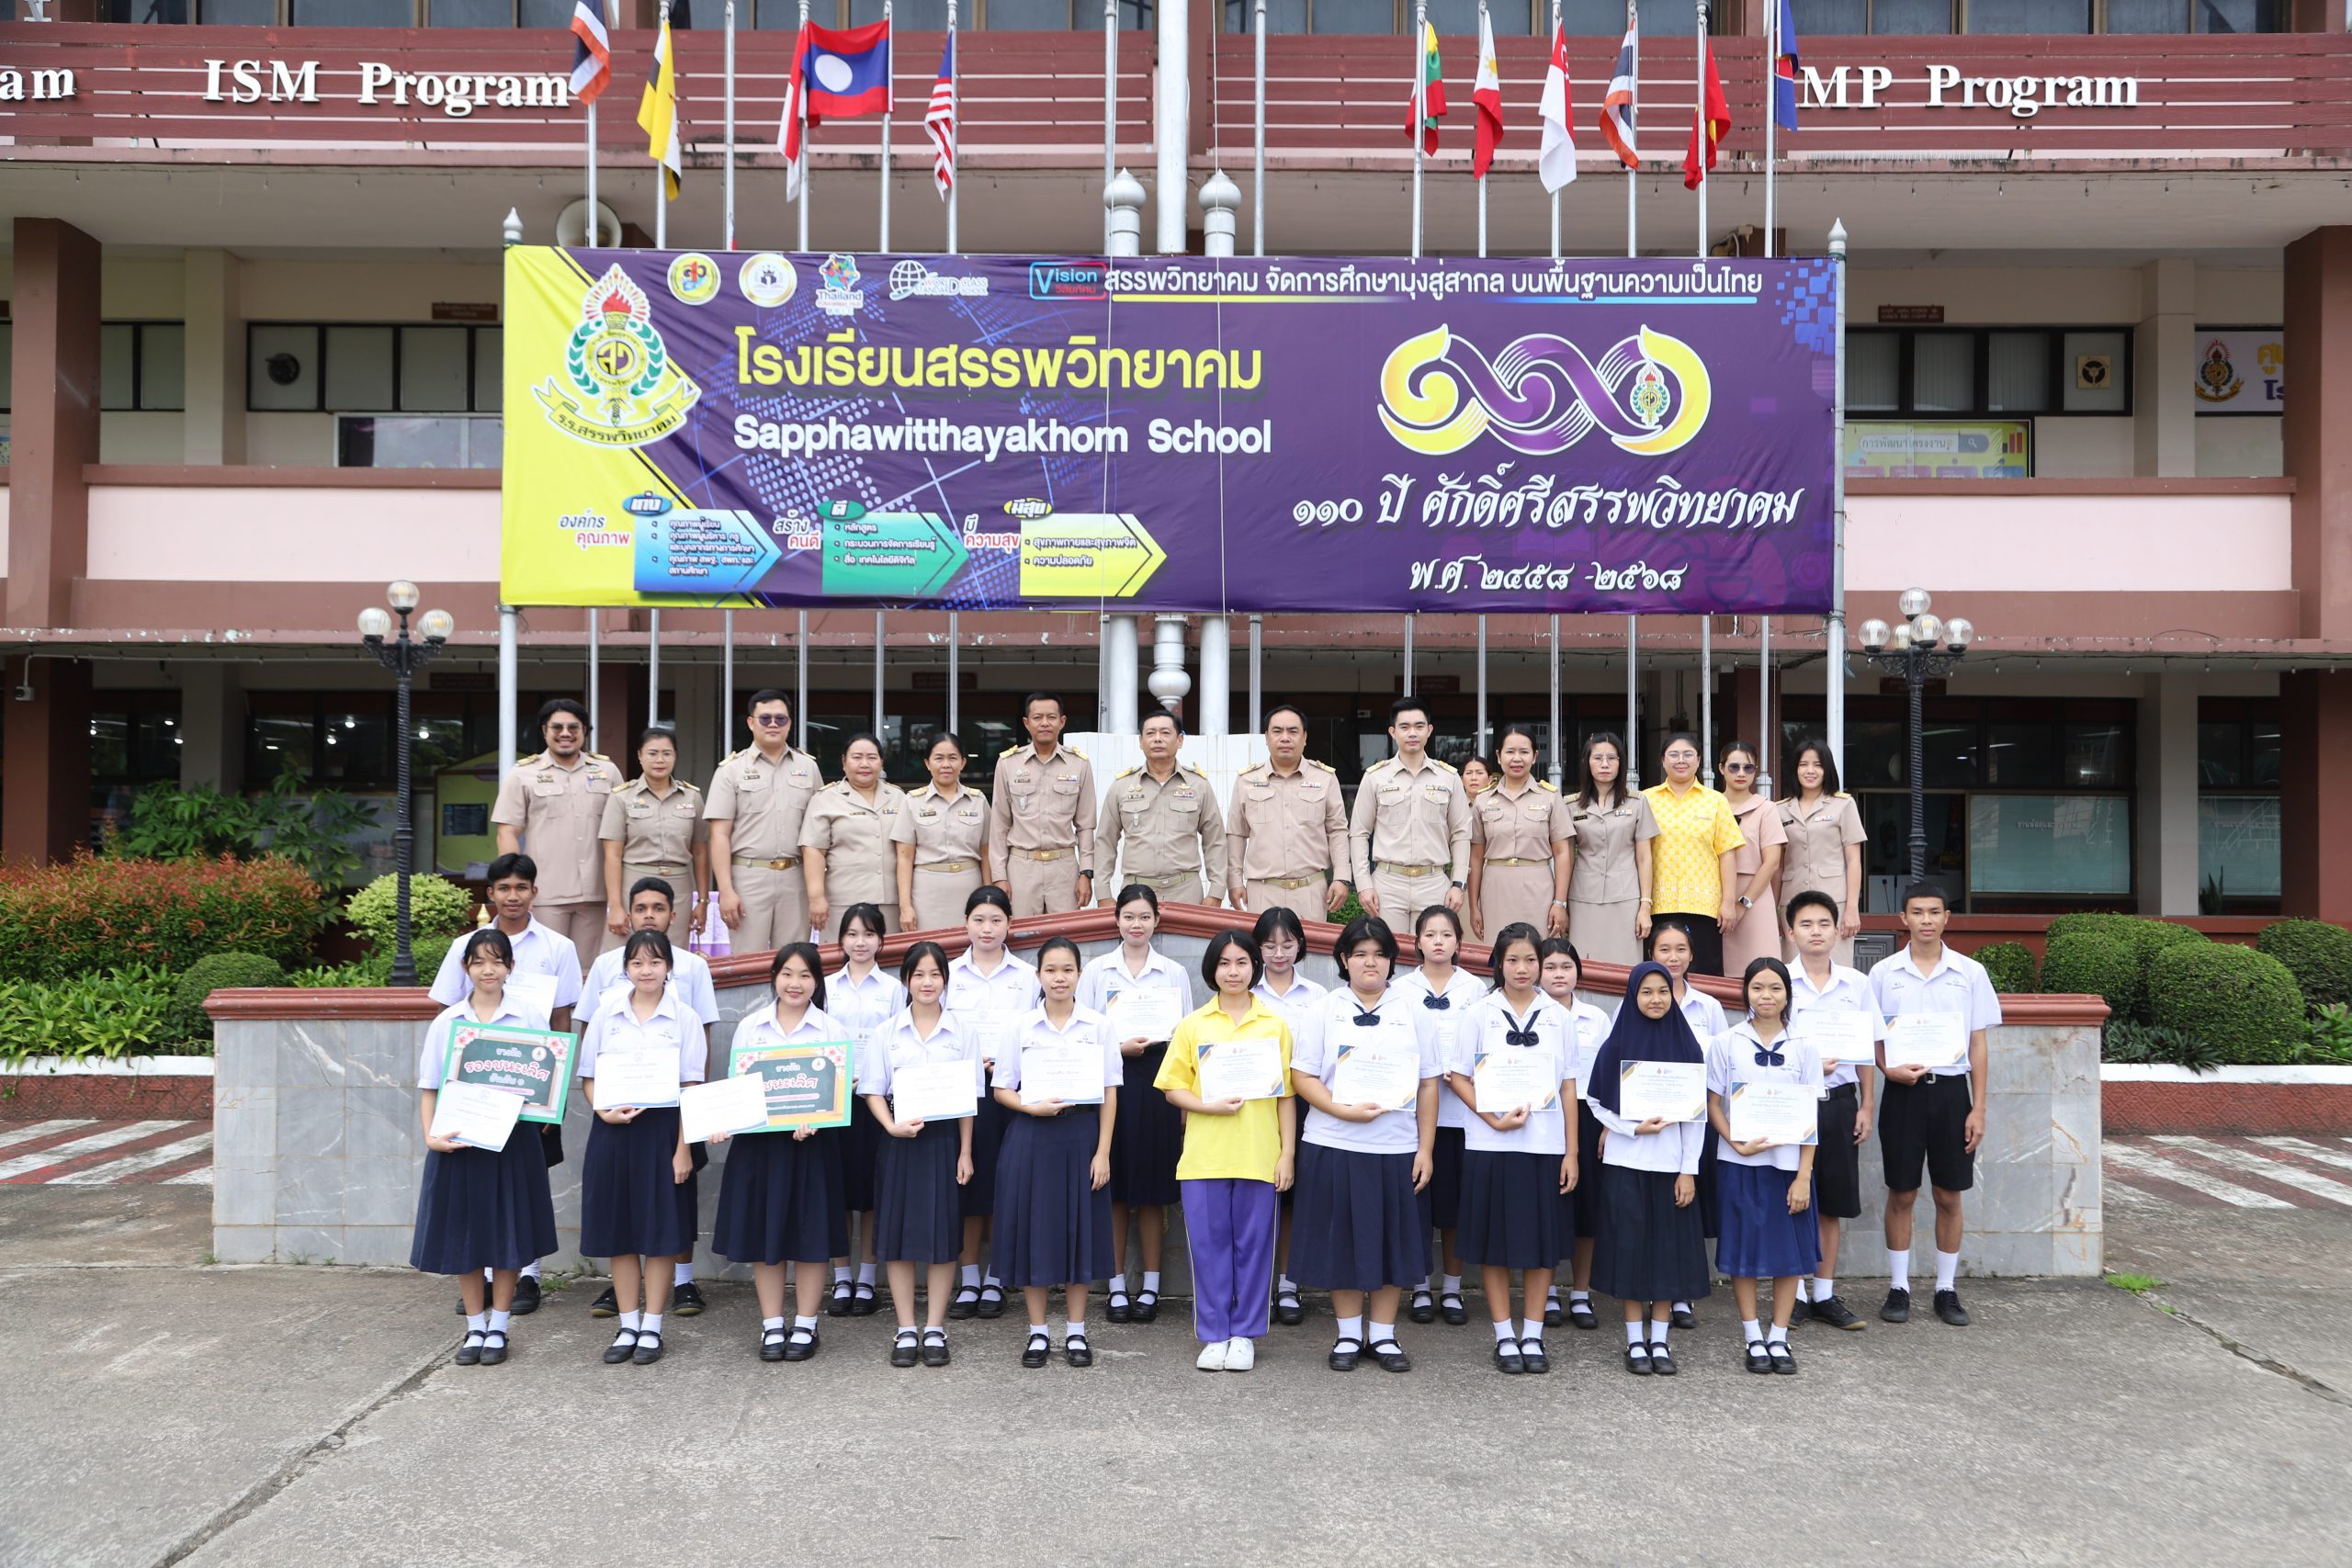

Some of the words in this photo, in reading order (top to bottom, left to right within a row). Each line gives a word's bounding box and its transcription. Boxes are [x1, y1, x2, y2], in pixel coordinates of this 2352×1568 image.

[203, 59, 321, 104] ISM
[358, 62, 571, 118] Program
[1926, 64, 2139, 118] Program
[1035, 268, 1098, 294] Vision
[1104, 266, 1257, 292] สรรพวิทยาคม
[1266, 258, 1505, 300] จัดการศึกษามุ่งสู่สากล
[1511, 258, 1763, 299] บนพื้นฐานความเป็นไทย
[818, 291, 862, 300] Thailand
[734, 325, 1263, 389] โรงเรียนสรรพวิทยาคม
[557, 413, 677, 443] ร.ร.สรรพวิทยาคม
[734, 417, 1128, 458] Sapphawitthayakhom
[1148, 419, 1272, 454] School
[1293, 498, 1363, 527] ๑๑๐
[1376, 473, 1416, 524] ปี
[1422, 460, 1805, 529] ศักดิ์ศรีสรรพวิทยาคม
[831, 501, 850, 516] ดี
[1012, 499, 1046, 518] มีสุข
[560, 509, 605, 529] องค์กร
[775, 511, 809, 533] สร้าง
[844, 523, 877, 535] หลักสูตร
[966, 515, 978, 533] มี
[576, 532, 630, 548] คุณภาพ
[790, 533, 820, 548] คนดี
[844, 537, 936, 551] กระบวนการจัดการเรียนรู้
[966, 534, 1020, 552] ความสุข
[1033, 555, 1093, 566] ความปลอดภัย
[1477, 561, 1575, 591] ๒๔๕๘
[465, 1059, 551, 1082] รองชนะเลิศ
[763, 1073, 819, 1091] ชนะเลิศ
